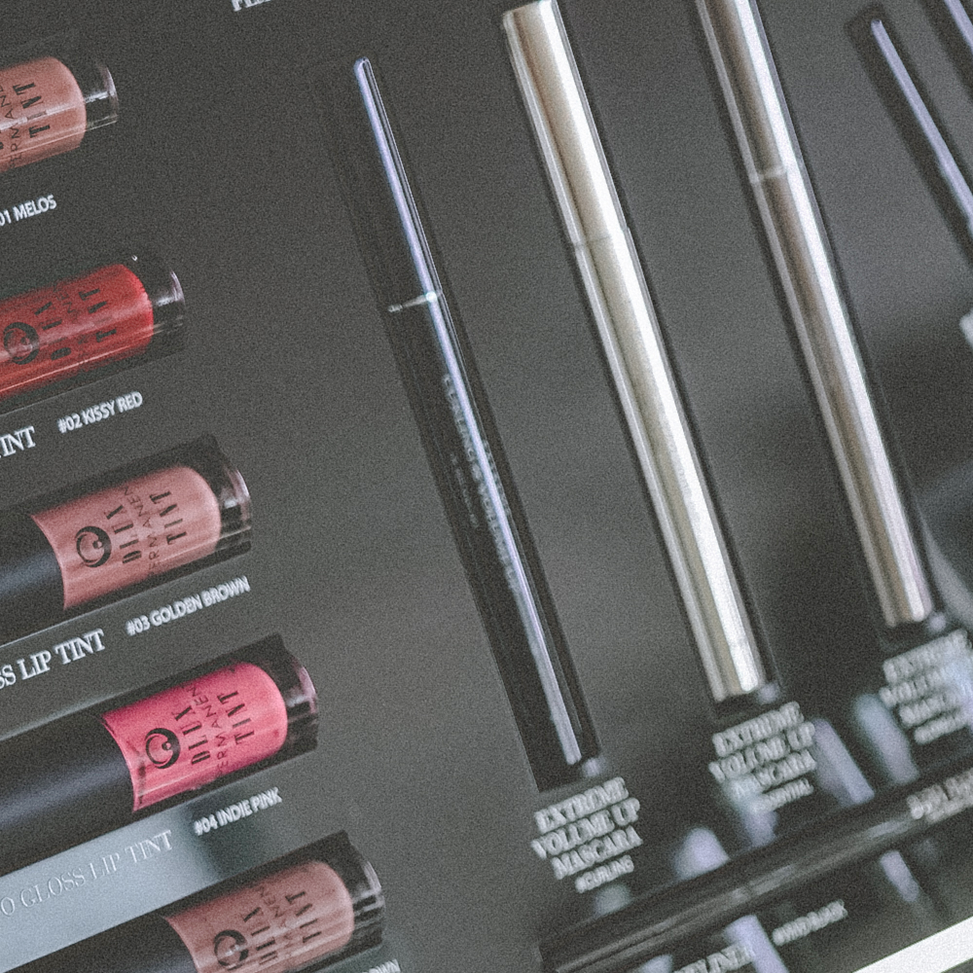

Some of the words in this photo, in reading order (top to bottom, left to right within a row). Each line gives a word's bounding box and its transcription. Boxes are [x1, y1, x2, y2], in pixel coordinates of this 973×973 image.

[12, 194, 57, 221] MELOS
[0, 425, 36, 457] INT
[57, 412, 83, 434] #02
[81, 400, 116, 425] KISSY
[116, 391, 143, 413] RED
[104, 505, 141, 564] DLUX
[149, 491, 187, 545] TINT
[16, 650, 51, 680] LIP
[54, 629, 105, 665] TINT
[125, 615, 150, 636] #03
[150, 594, 202, 627] GOLDEN
[200, 575, 251, 606] BROWN
[171, 706, 211, 765] DLUX
[217, 691, 254, 745] TINT
[20, 868, 85, 908] GLOSS
[89, 852, 120, 880] LIP
[125, 829, 173, 864] TINT
[193, 814, 218, 836] #04
[216, 800, 253, 827] INDIE
[249, 787, 282, 813] PINK
